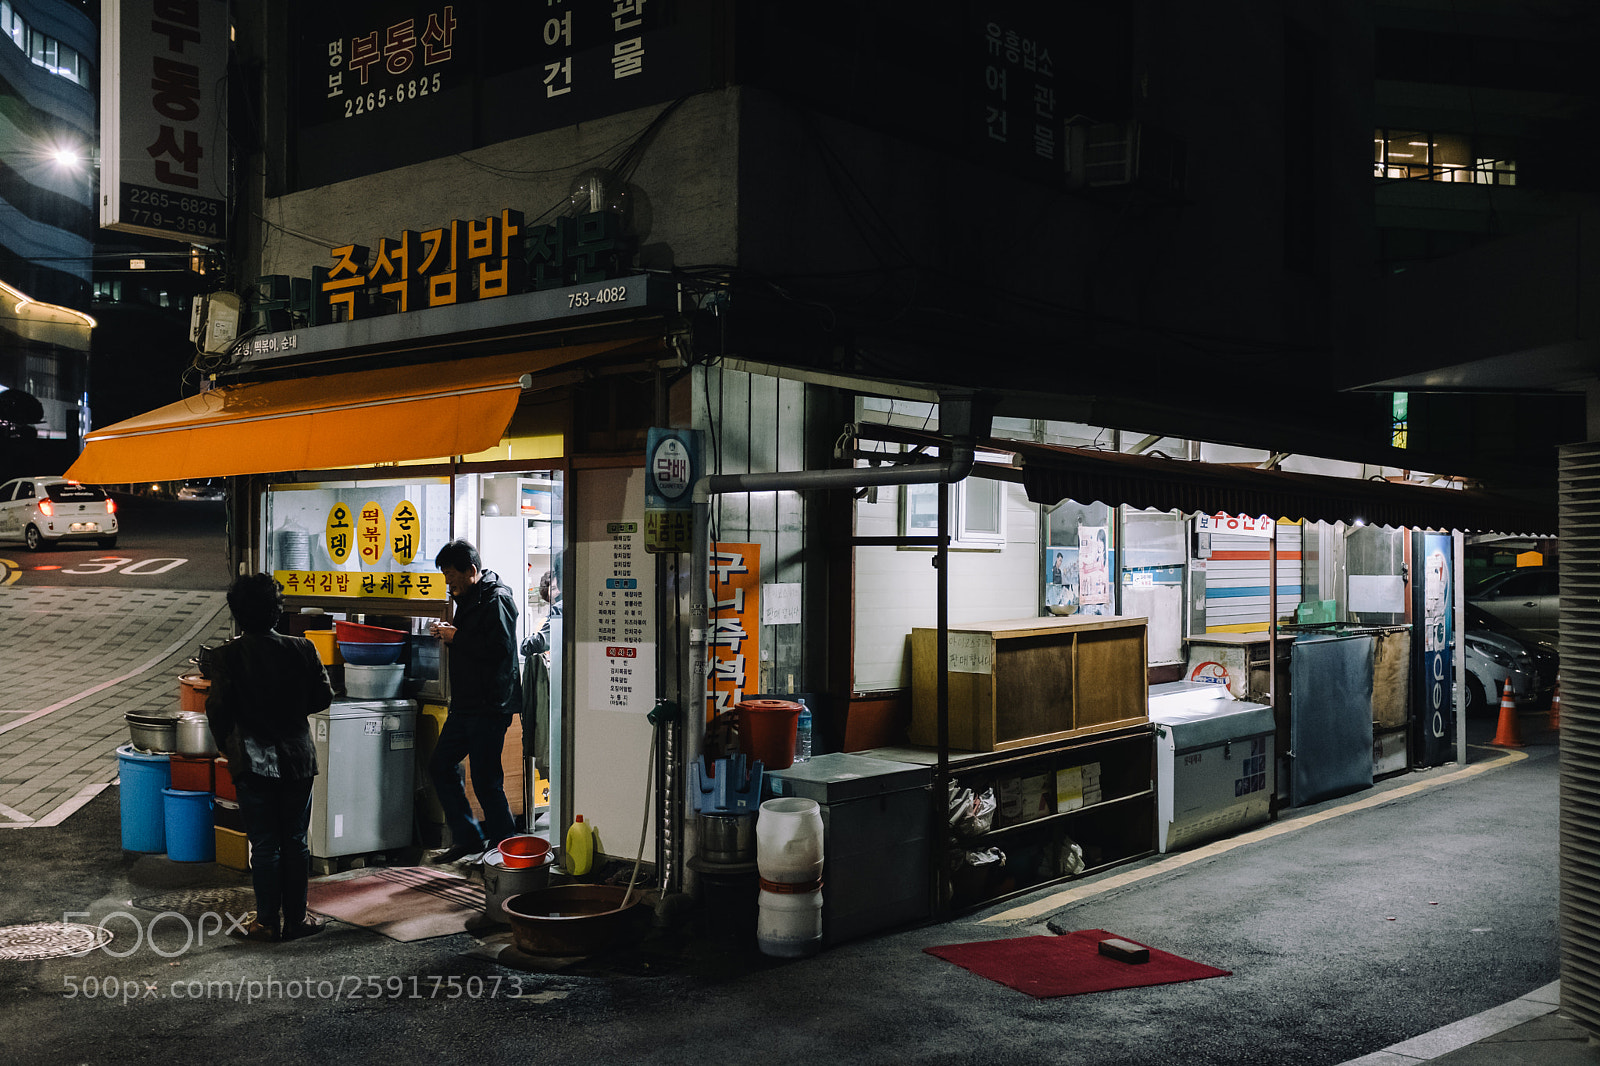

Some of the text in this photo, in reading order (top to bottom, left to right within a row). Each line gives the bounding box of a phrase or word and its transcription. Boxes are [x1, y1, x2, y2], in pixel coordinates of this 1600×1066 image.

[349, 5, 457, 86] 부동산
[985, 22, 1054, 79] 유흥업소
[327, 38, 343, 98] 명보
[130, 188, 217, 216] 2265-6825
[130, 208, 217, 236] 779-3594
[321, 208, 519, 321] 즉석김밥
[568, 286, 626, 309] 753-4082
[281, 334, 297, 350] 순대
[657, 458, 687, 482] 담배
[330, 507, 349, 557] 오뎅
[362, 508, 381, 560] 떡볶이
[394, 506, 415, 559] 순대
[61, 557, 189, 576] 30
[286, 573, 432, 596] 즉석김밥 단체주문
